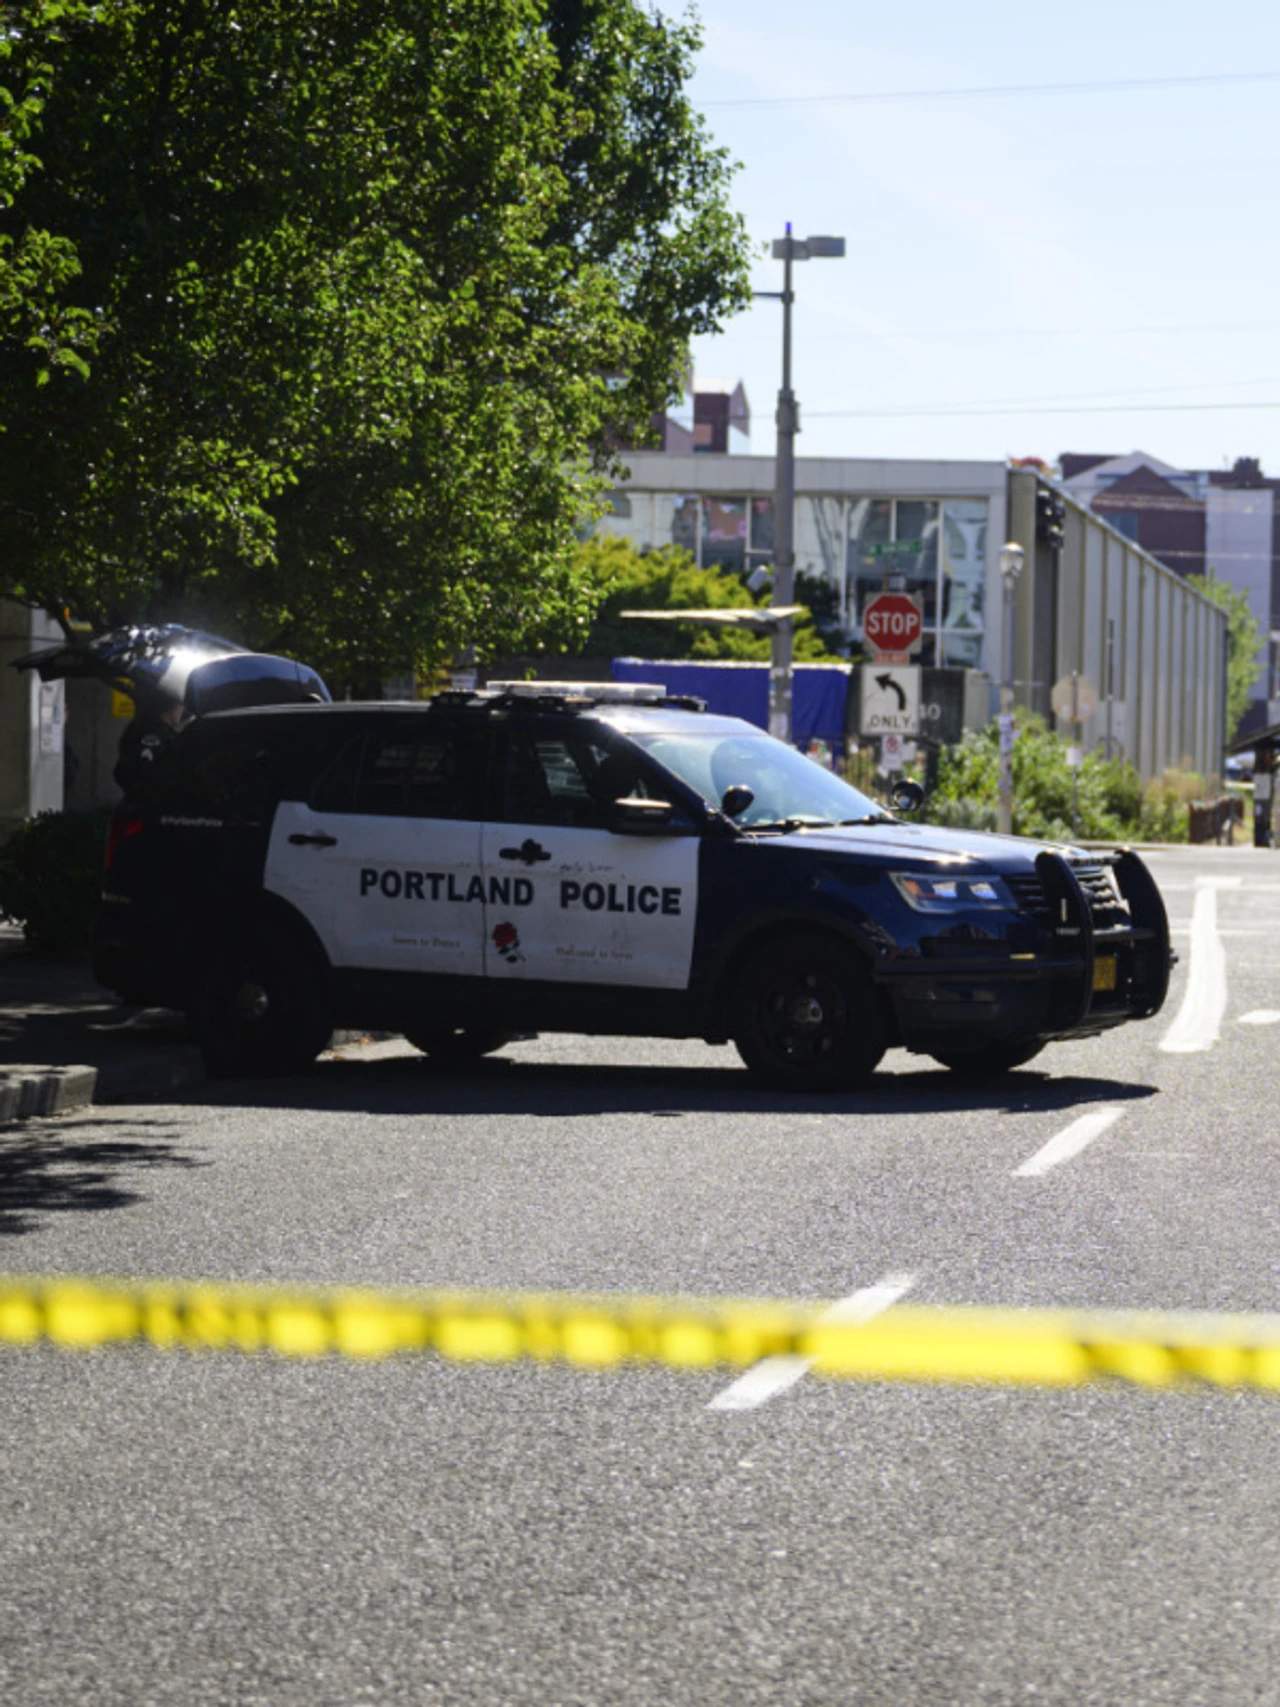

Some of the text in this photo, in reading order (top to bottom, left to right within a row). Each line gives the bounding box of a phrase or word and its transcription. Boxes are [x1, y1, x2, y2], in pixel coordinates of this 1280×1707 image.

[868, 612, 919, 636] STOP
[869, 714, 913, 729] ONLY
[359, 867, 683, 916] PORTLAND POLICE
